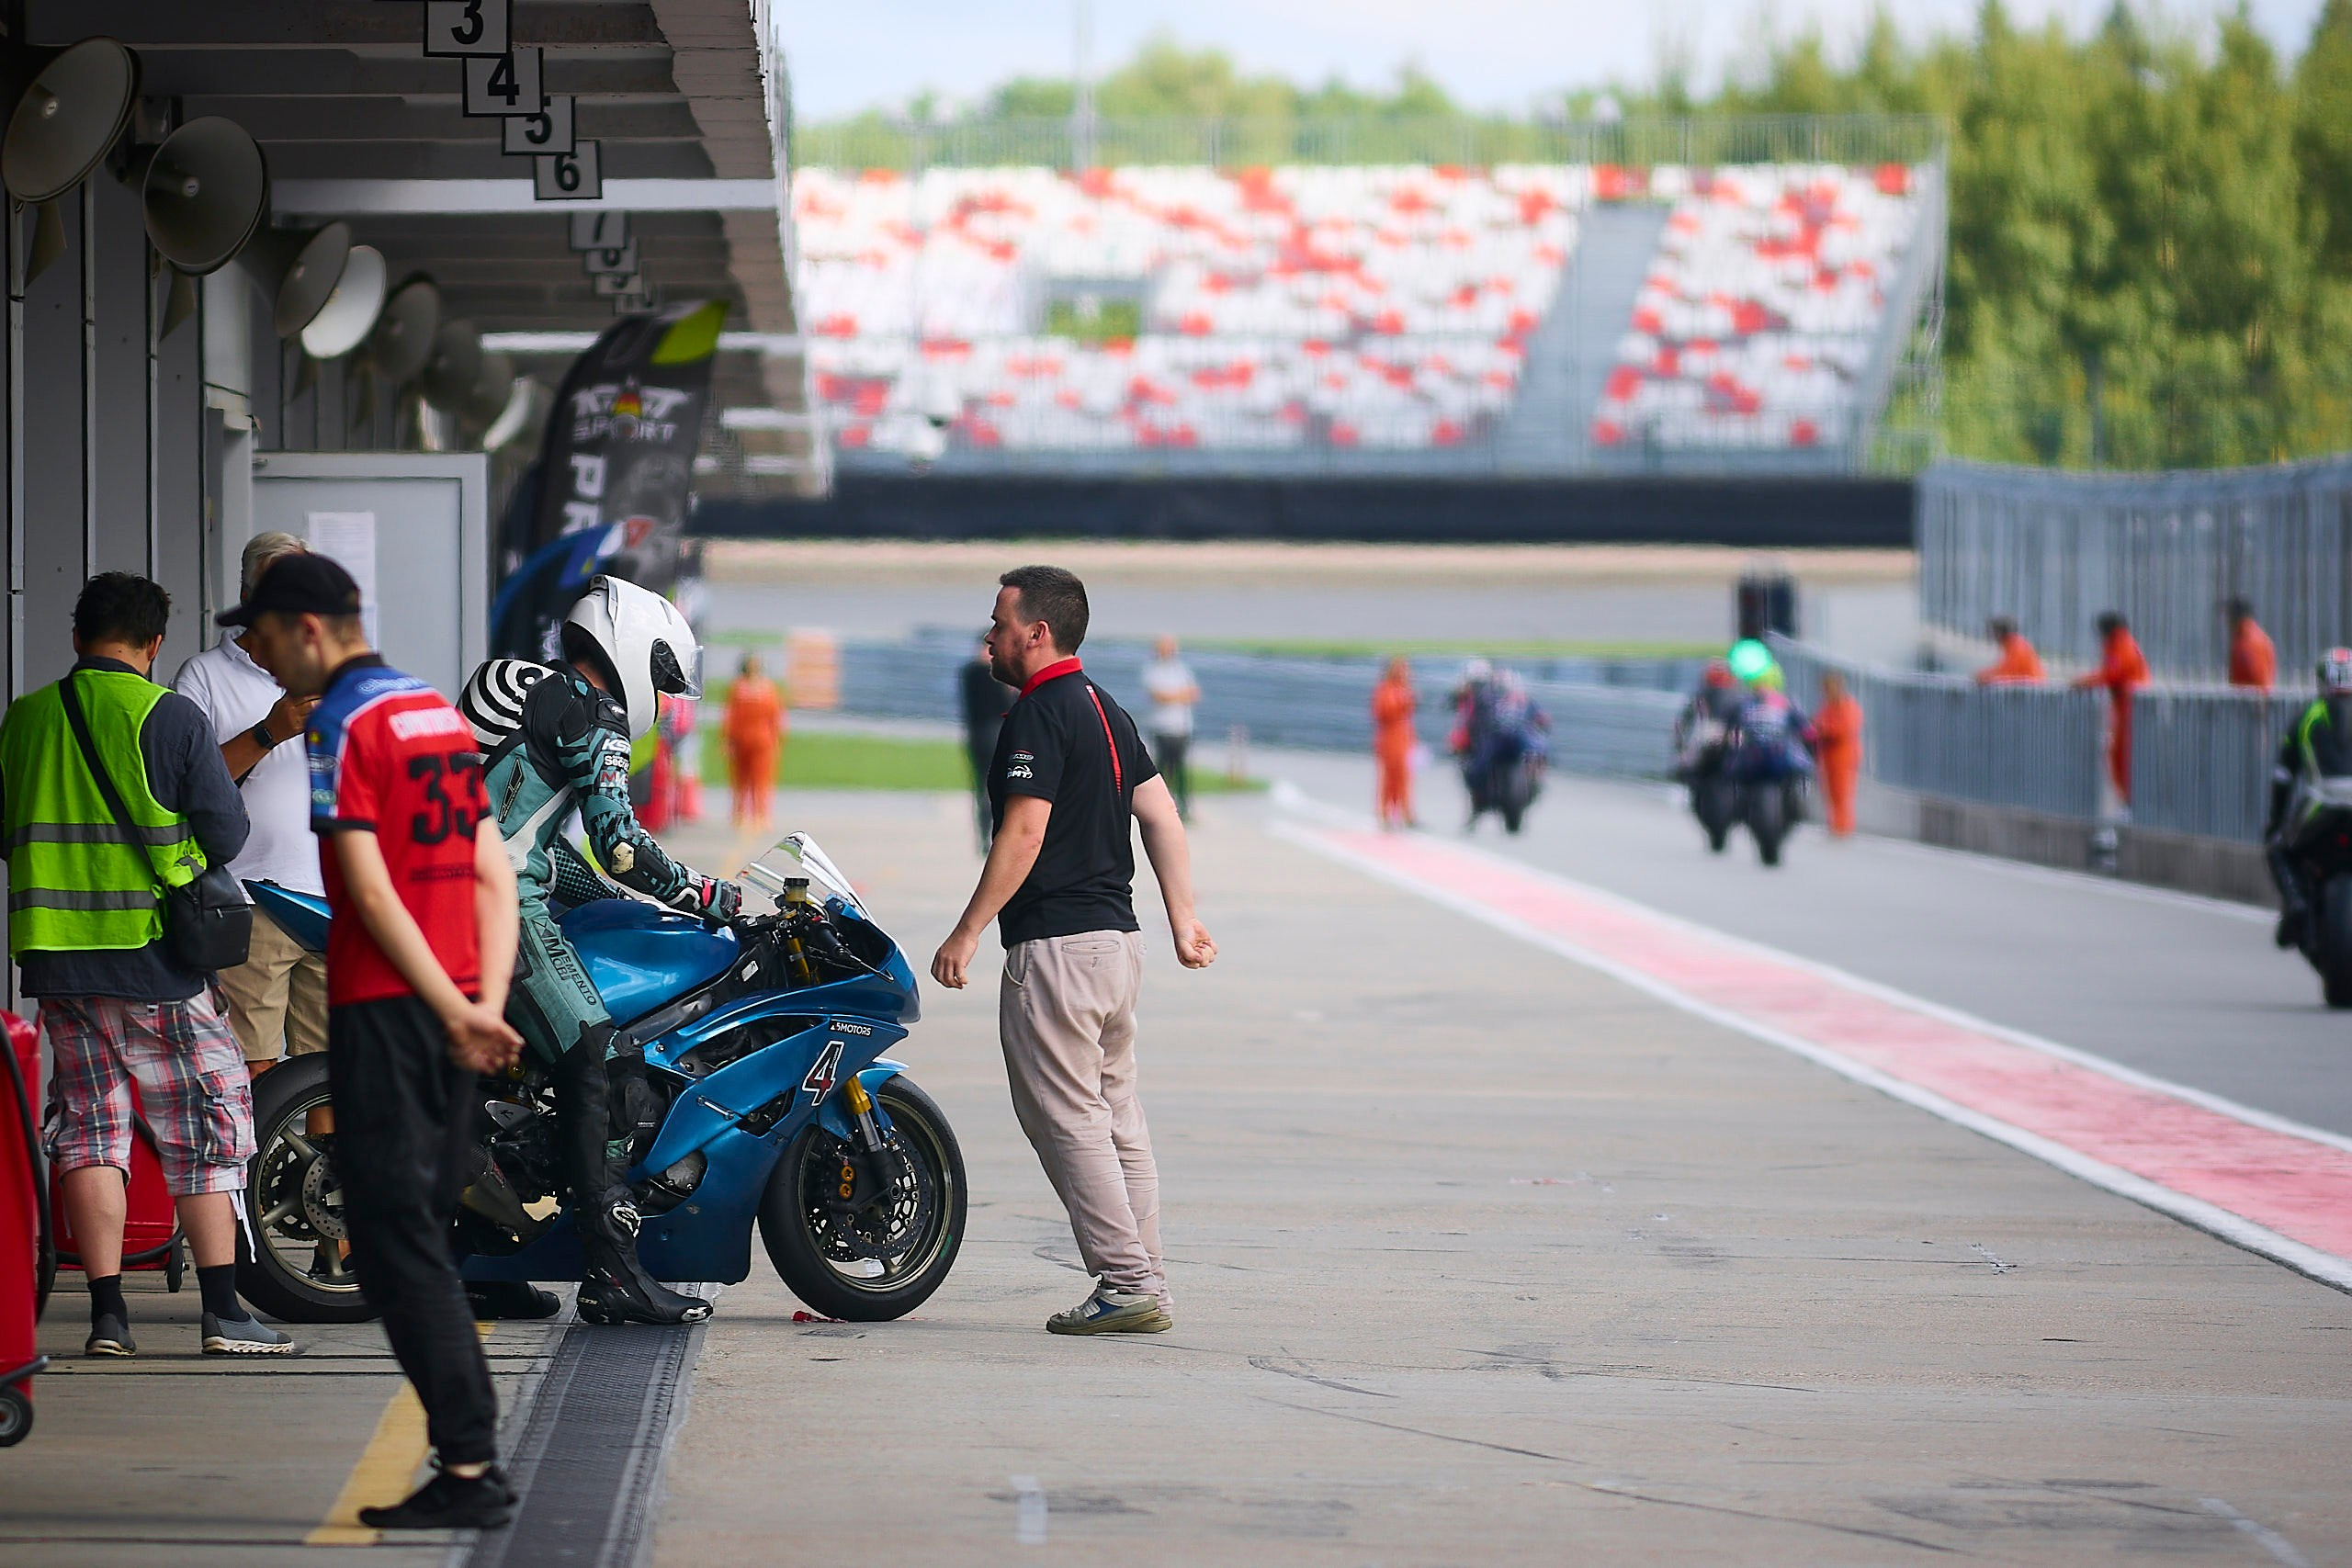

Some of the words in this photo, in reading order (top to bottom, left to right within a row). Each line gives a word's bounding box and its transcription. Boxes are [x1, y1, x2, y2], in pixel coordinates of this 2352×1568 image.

[450, 0, 485, 45] 3
[487, 57, 520, 107] 4
[525, 96, 552, 145] 5
[554, 153, 582, 192] 6
[802, 1040, 845, 1107] 4
